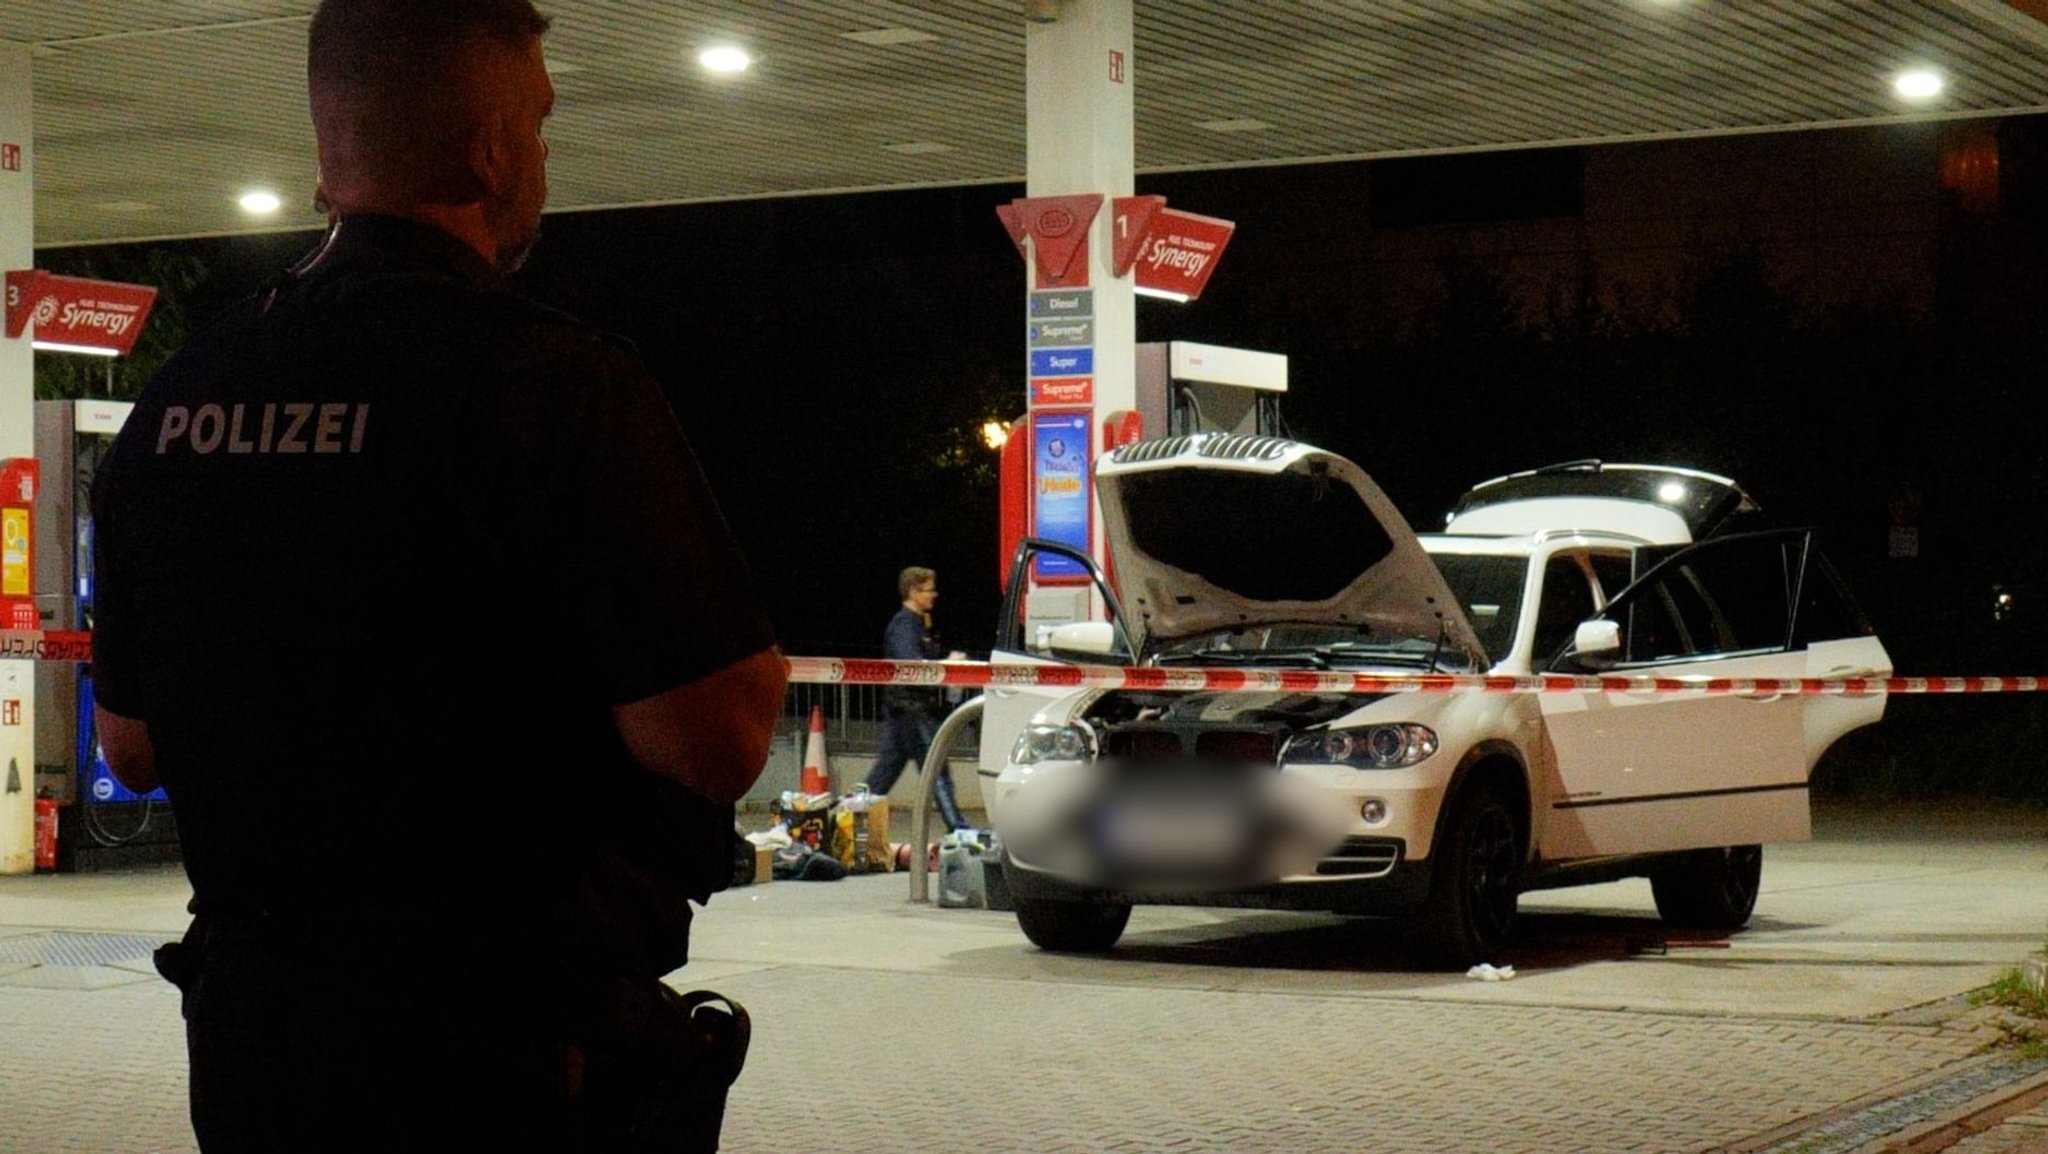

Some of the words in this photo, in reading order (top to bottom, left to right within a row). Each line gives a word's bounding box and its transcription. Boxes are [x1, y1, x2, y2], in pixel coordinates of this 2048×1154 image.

[1116, 214, 1128, 238] 1
[1147, 239, 1211, 278] Synergy
[7, 286, 19, 306] 3
[59, 303, 136, 336] Synergy
[1049, 356, 1078, 370] Super
[155, 402, 371, 455] POLIZEI
